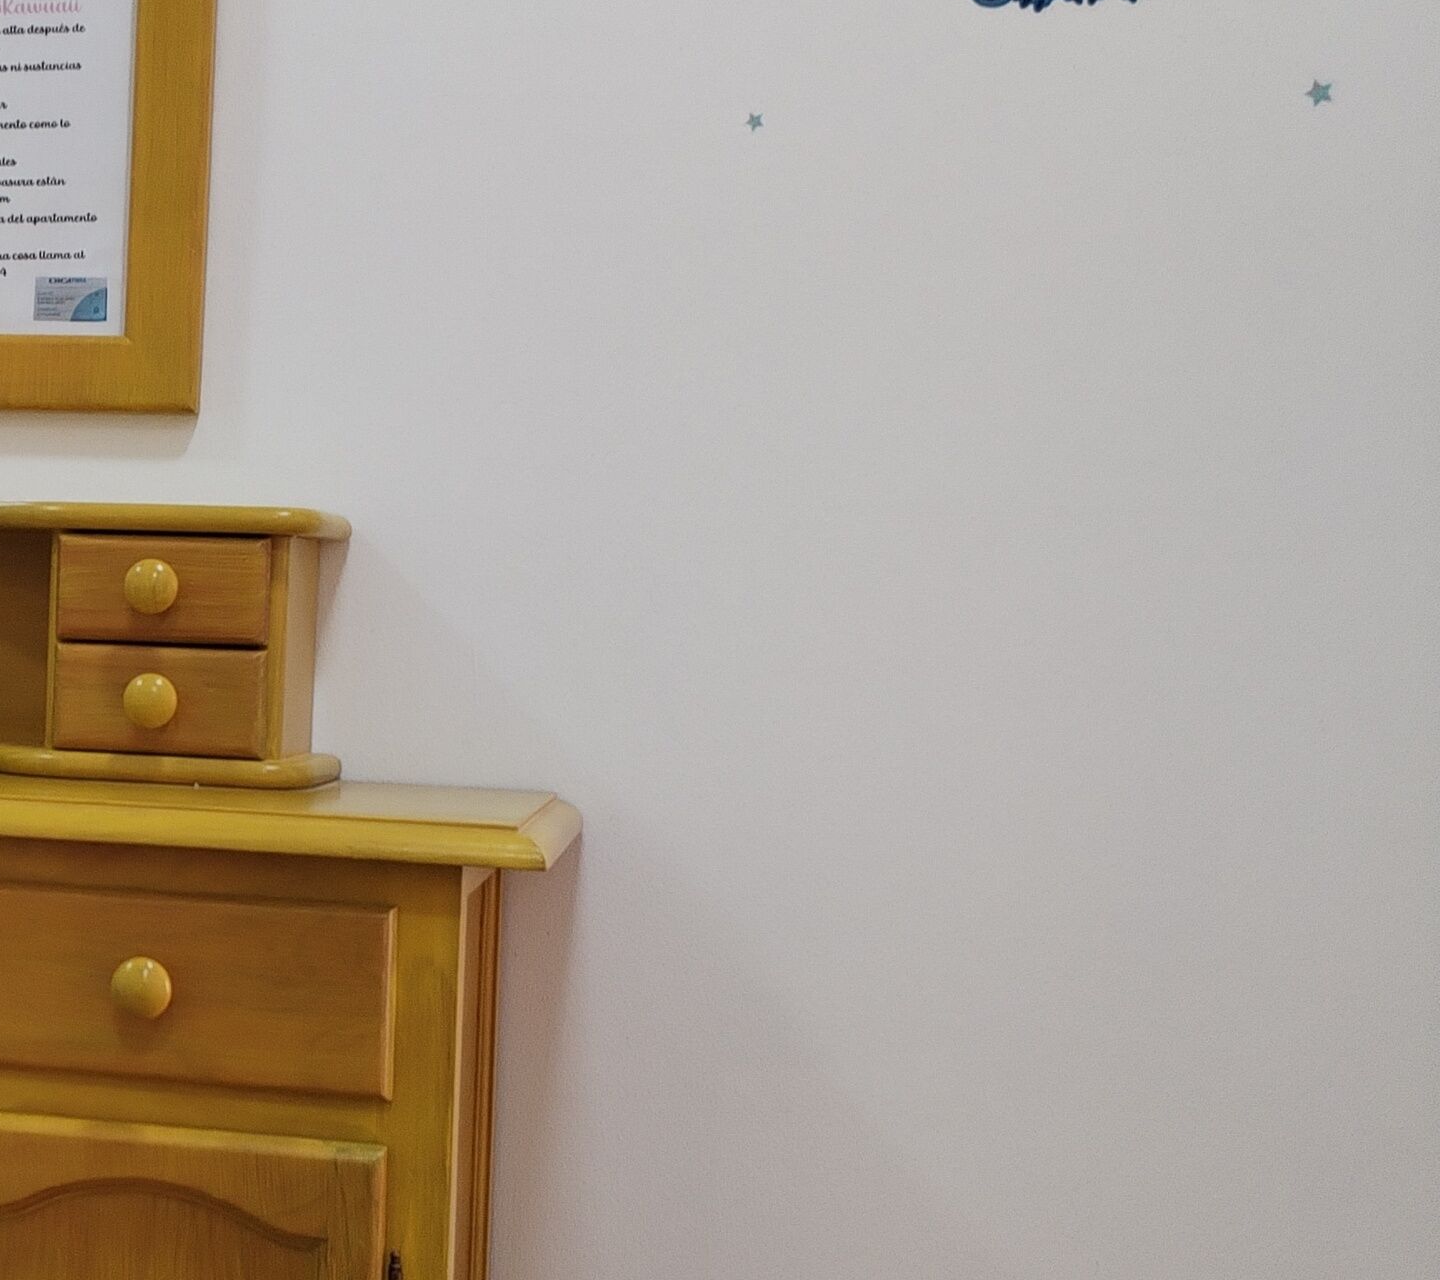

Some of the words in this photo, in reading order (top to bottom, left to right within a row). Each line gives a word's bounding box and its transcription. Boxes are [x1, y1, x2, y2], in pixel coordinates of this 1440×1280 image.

[2, 24, 25, 35] alta
[72, 23, 86, 33] de
[10, 63, 22, 72] ni
[23, 61, 82, 72] sustancias
[29, 120, 58, 129] como
[59, 118, 71, 128] lo
[36, 176, 66, 186] están
[7, 213, 24, 224] del
[26, 212, 98, 226] apartamento
[12, 252, 37, 260] cosa
[39, 250, 72, 260] llama
[73, 250, 85, 260] al
